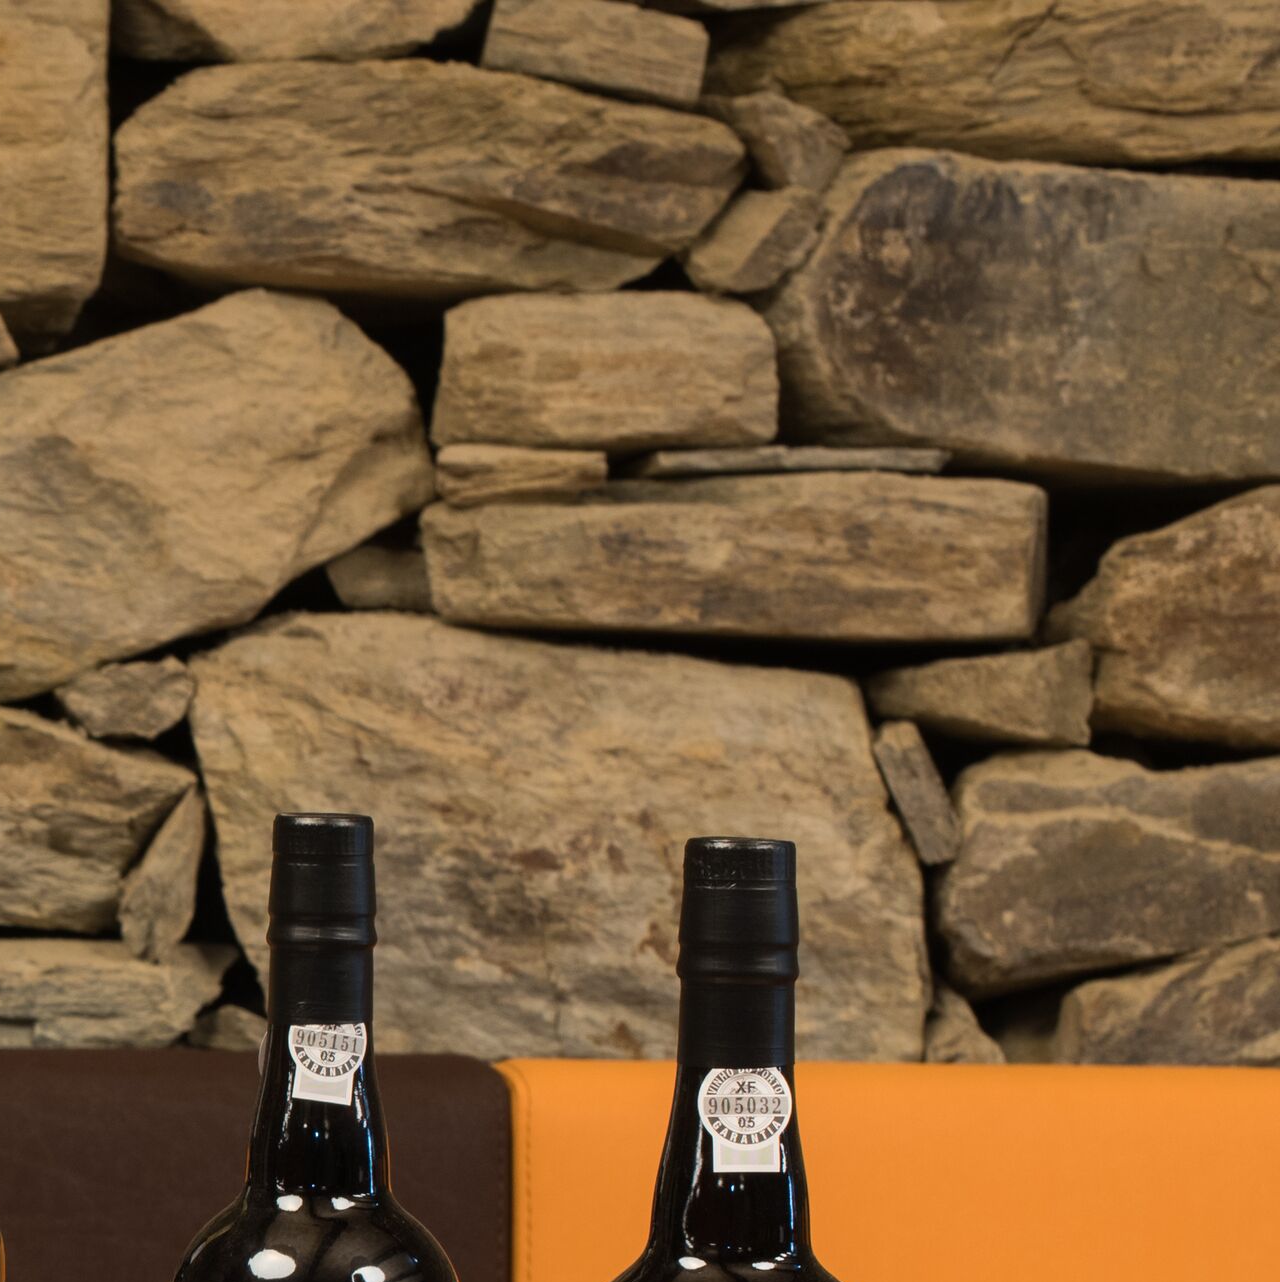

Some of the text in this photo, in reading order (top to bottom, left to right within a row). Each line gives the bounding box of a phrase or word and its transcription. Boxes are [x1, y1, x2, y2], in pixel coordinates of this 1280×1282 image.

[296, 1029, 357, 1053] 905151
[298, 1051, 357, 1077] GARANTIA
[736, 1081, 756, 1093] XF
[708, 1097, 781, 1115] 905032
[712, 1120, 782, 1144] GARANTIA
[738, 1117, 755, 1128] 05
